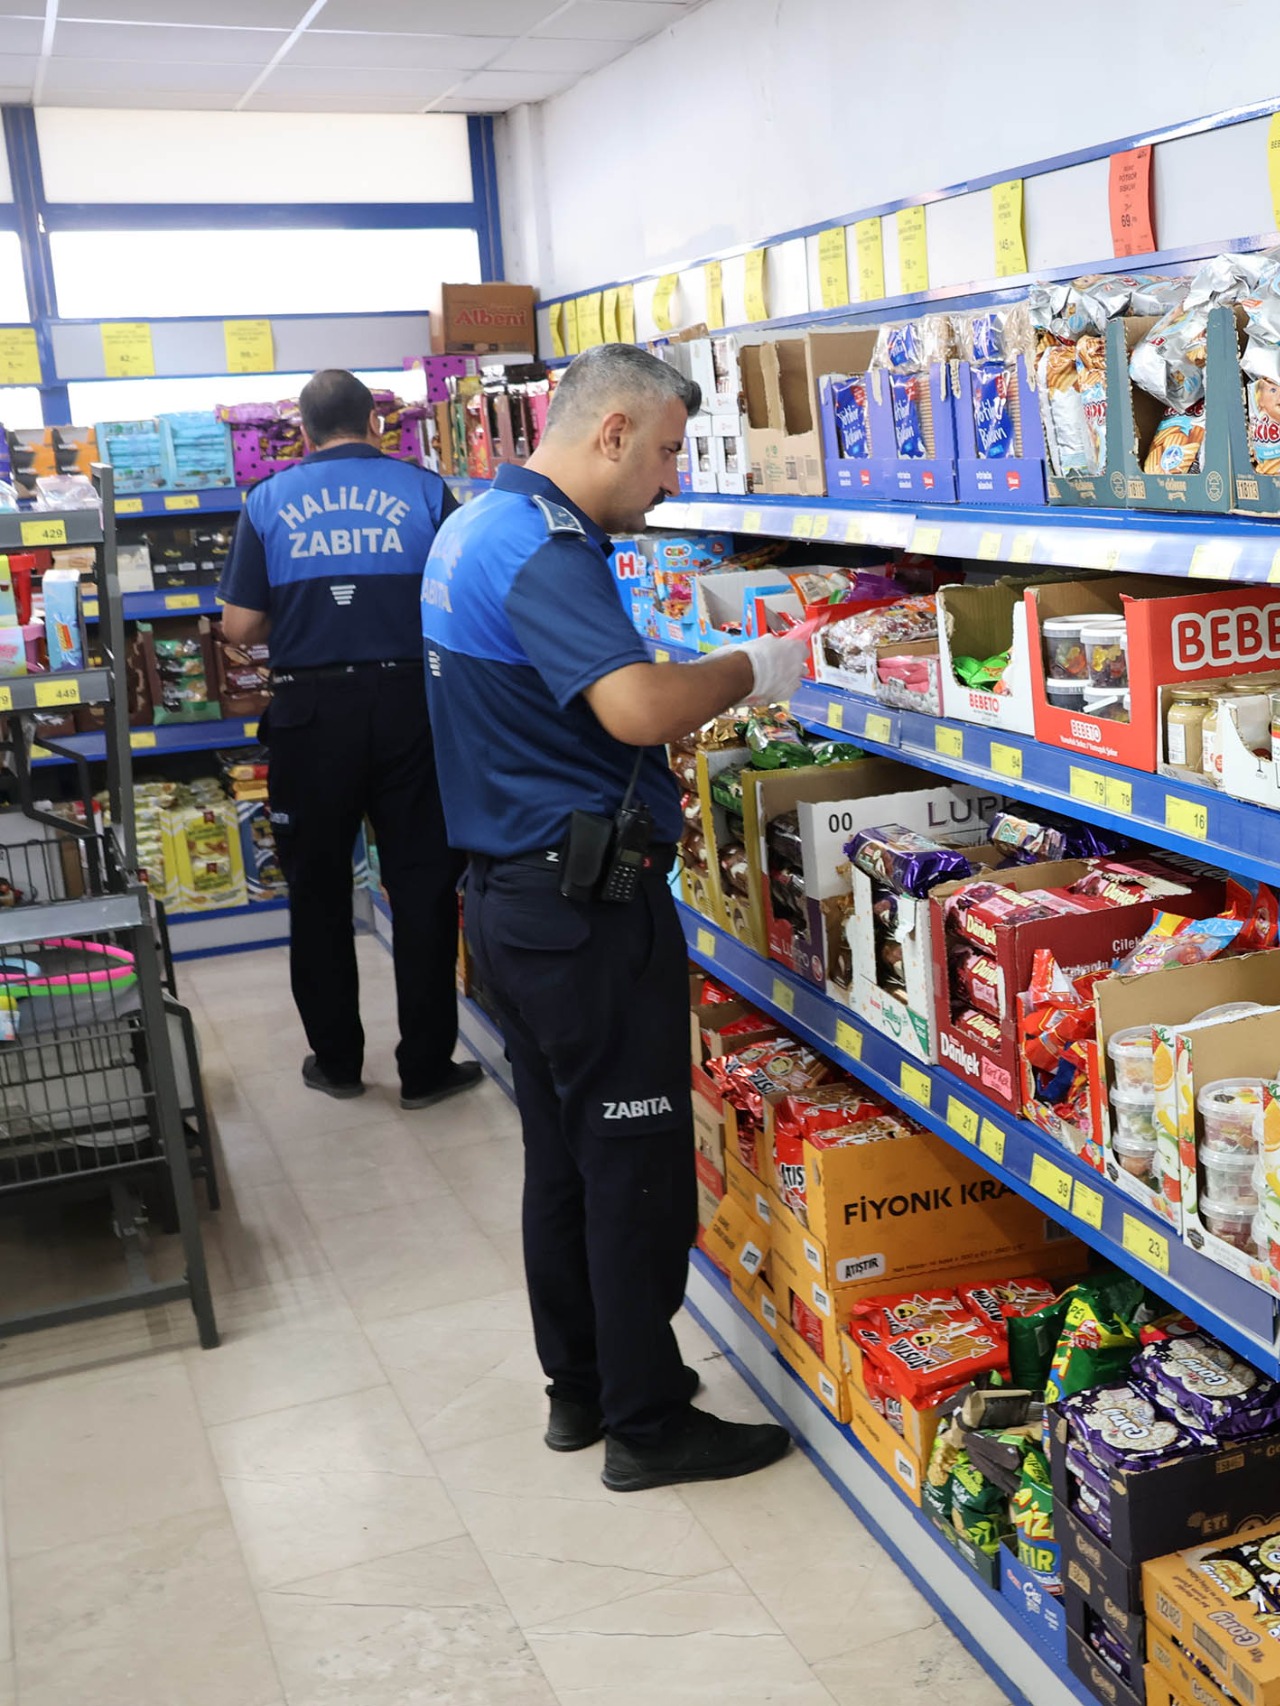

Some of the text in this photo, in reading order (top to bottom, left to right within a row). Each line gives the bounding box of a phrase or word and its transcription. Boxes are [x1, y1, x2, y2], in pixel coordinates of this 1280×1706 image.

[454, 309, 527, 328] Albeni
[42, 528, 64, 539] 429
[288, 527, 404, 559] ZABITA
[55, 689, 77, 700] 449
[968, 692, 1000, 713] BEBETO
[1070, 719, 1102, 743] BEBETO
[1193, 812, 1205, 829] 16
[939, 1031, 980, 1077] Dankek
[602, 1096, 673, 1119] ZABITA
[1057, 1179, 1069, 1197] 39
[843, 1177, 1018, 1226] FİYONK KRA
[1207, 1610, 1262, 1647] Gong
